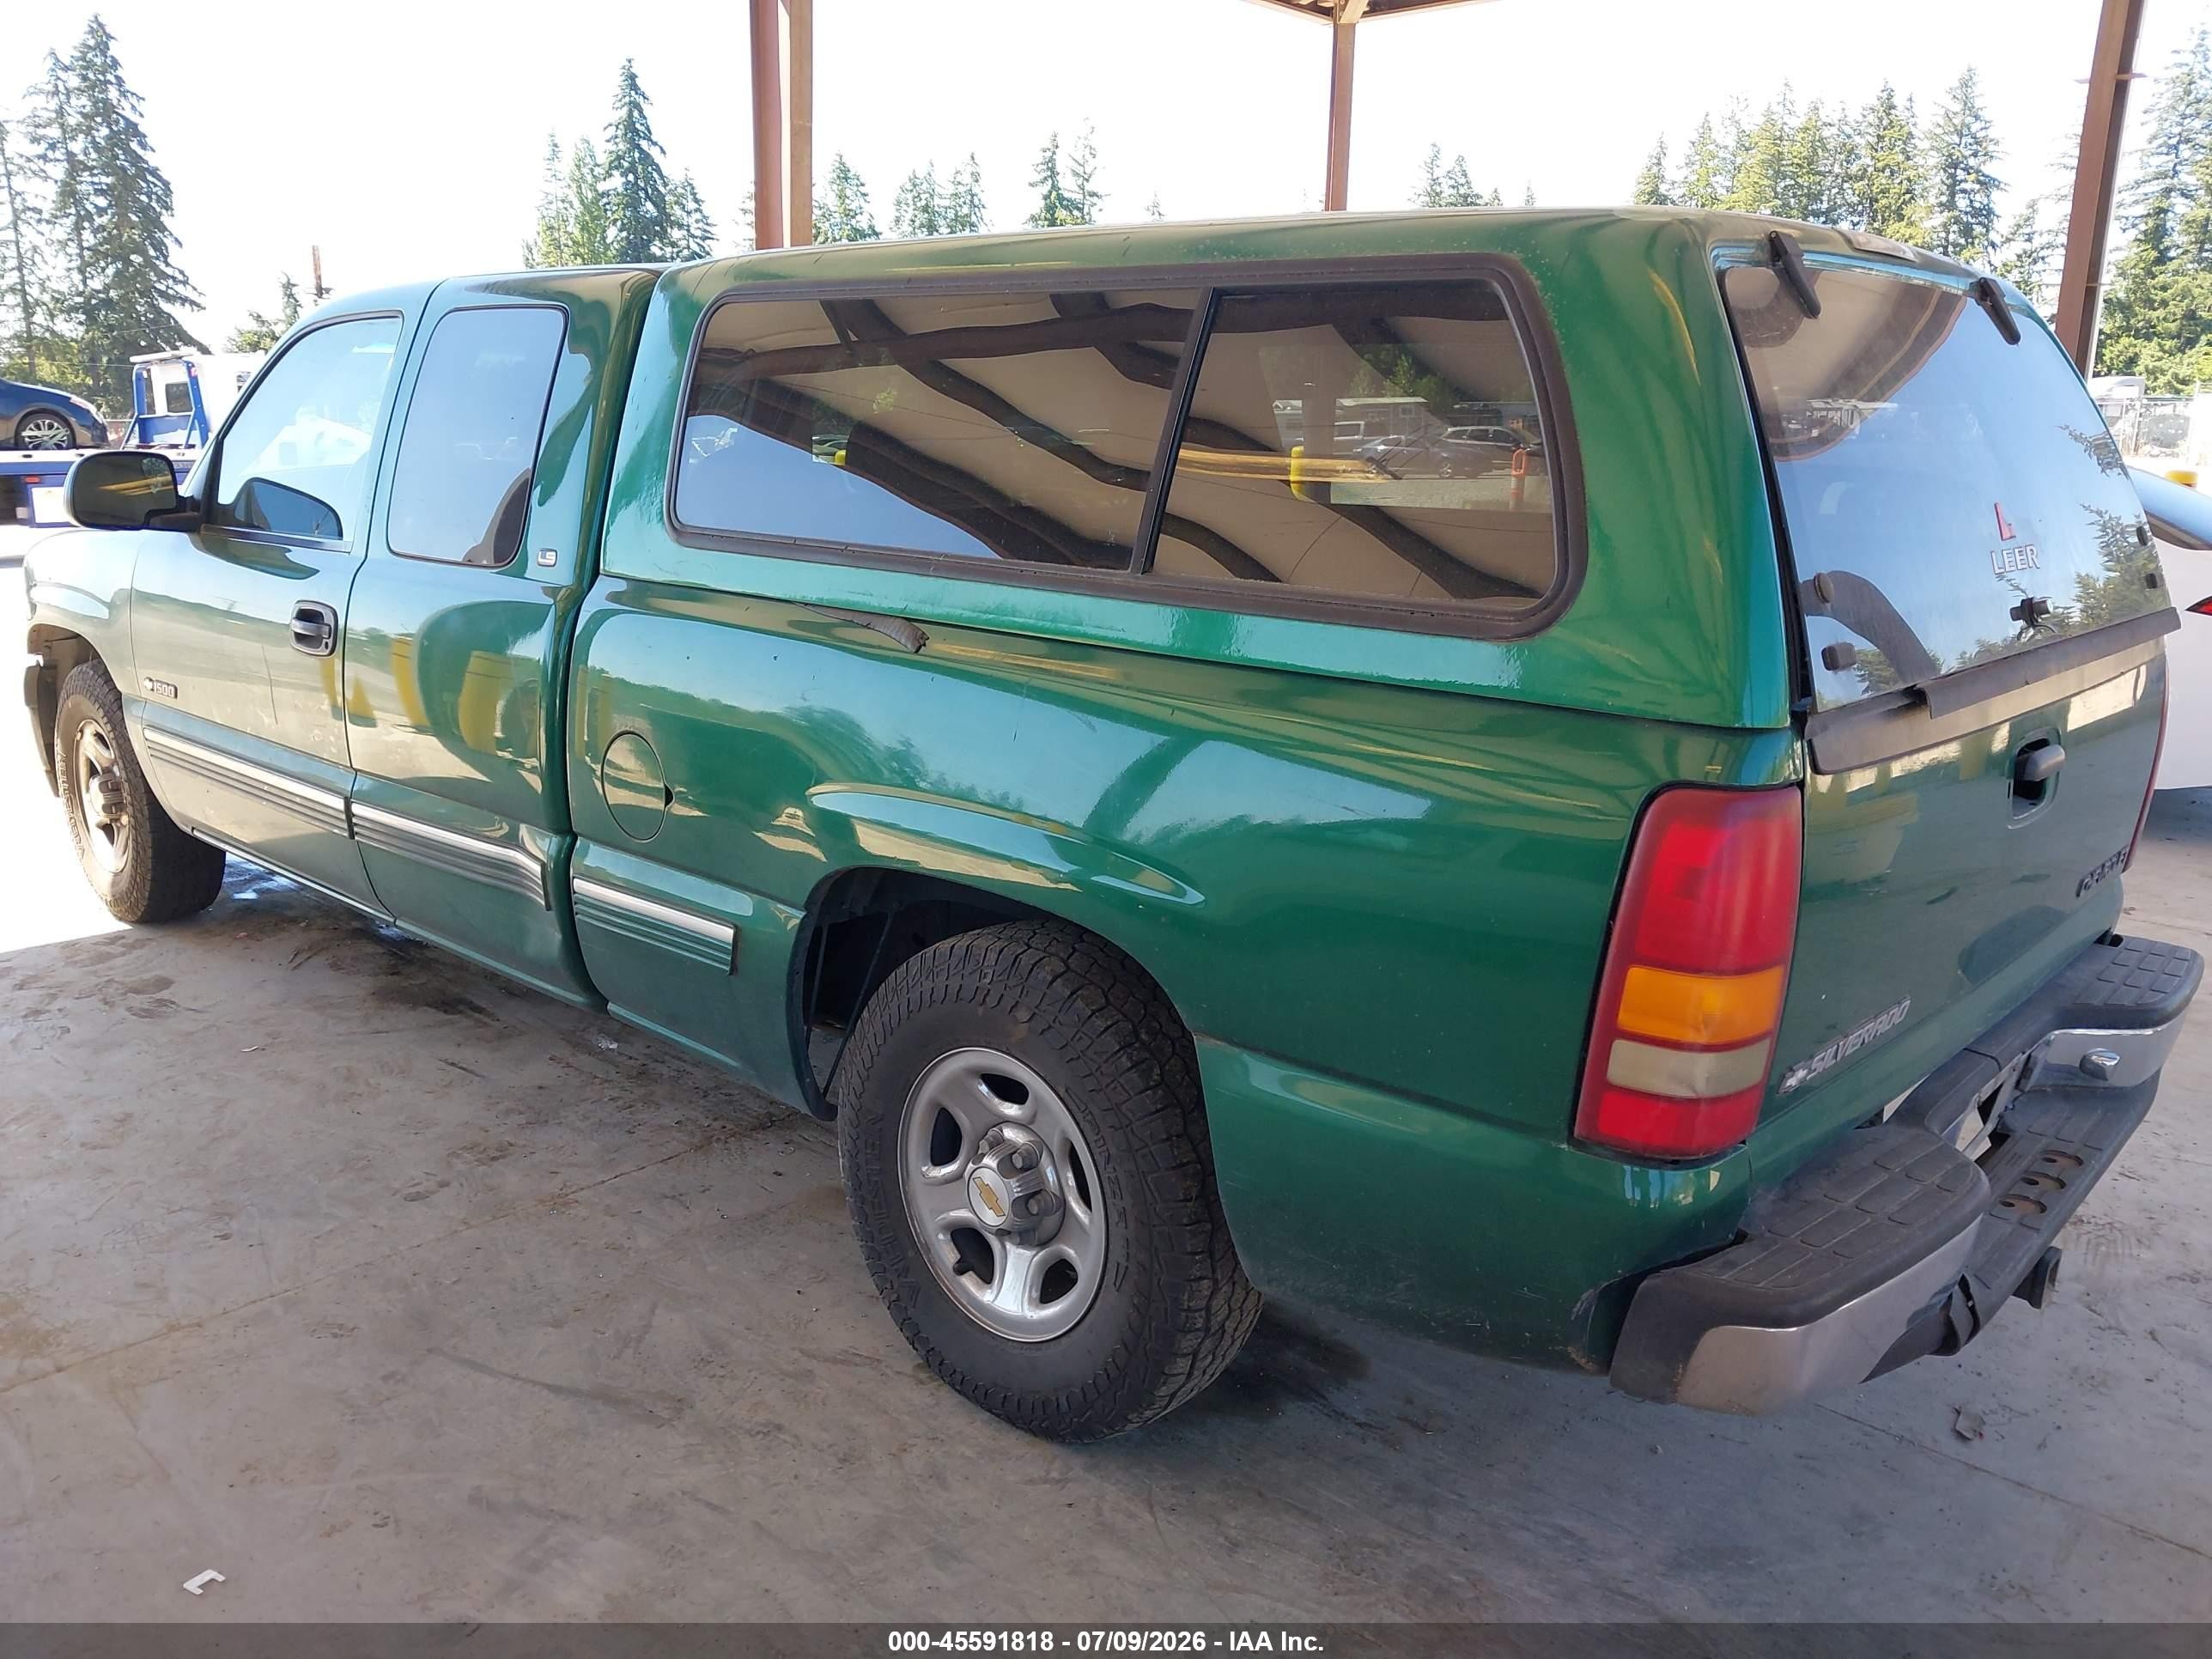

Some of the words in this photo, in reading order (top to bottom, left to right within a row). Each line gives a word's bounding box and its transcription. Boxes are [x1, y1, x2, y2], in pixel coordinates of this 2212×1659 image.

[1990, 544, 2040, 575] LEER
[153, 681, 175, 698] 1500
[1807, 999, 1911, 1079] SILVERADO
